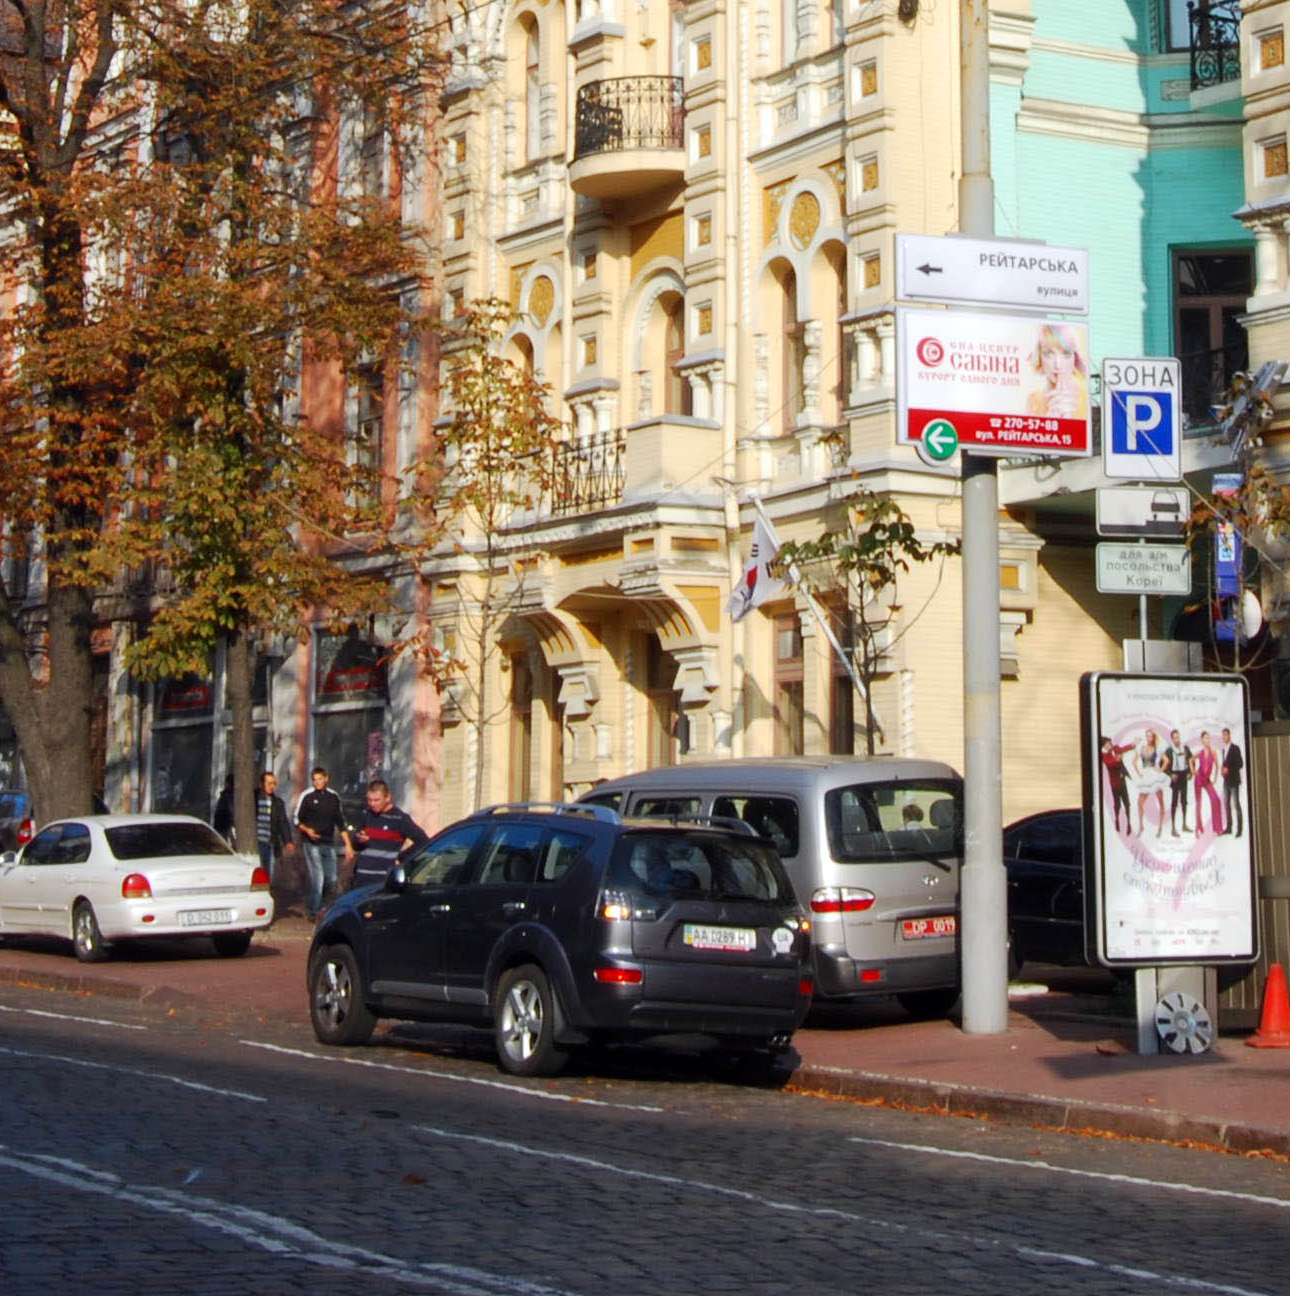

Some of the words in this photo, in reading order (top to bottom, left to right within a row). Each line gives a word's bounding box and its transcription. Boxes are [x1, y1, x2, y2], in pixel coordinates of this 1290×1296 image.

[979, 252, 1079, 274] РЕЙТАРСЬКА
[1036, 285, 1078, 298] вулиця
[1109, 365, 1175, 387] ЗОНА
[1004, 417, 1059, 432] 270-57-88
[1126, 395, 1162, 450] P
[1105, 561, 1182, 573] посольства
[1125, 574, 1164, 588] Кореї
